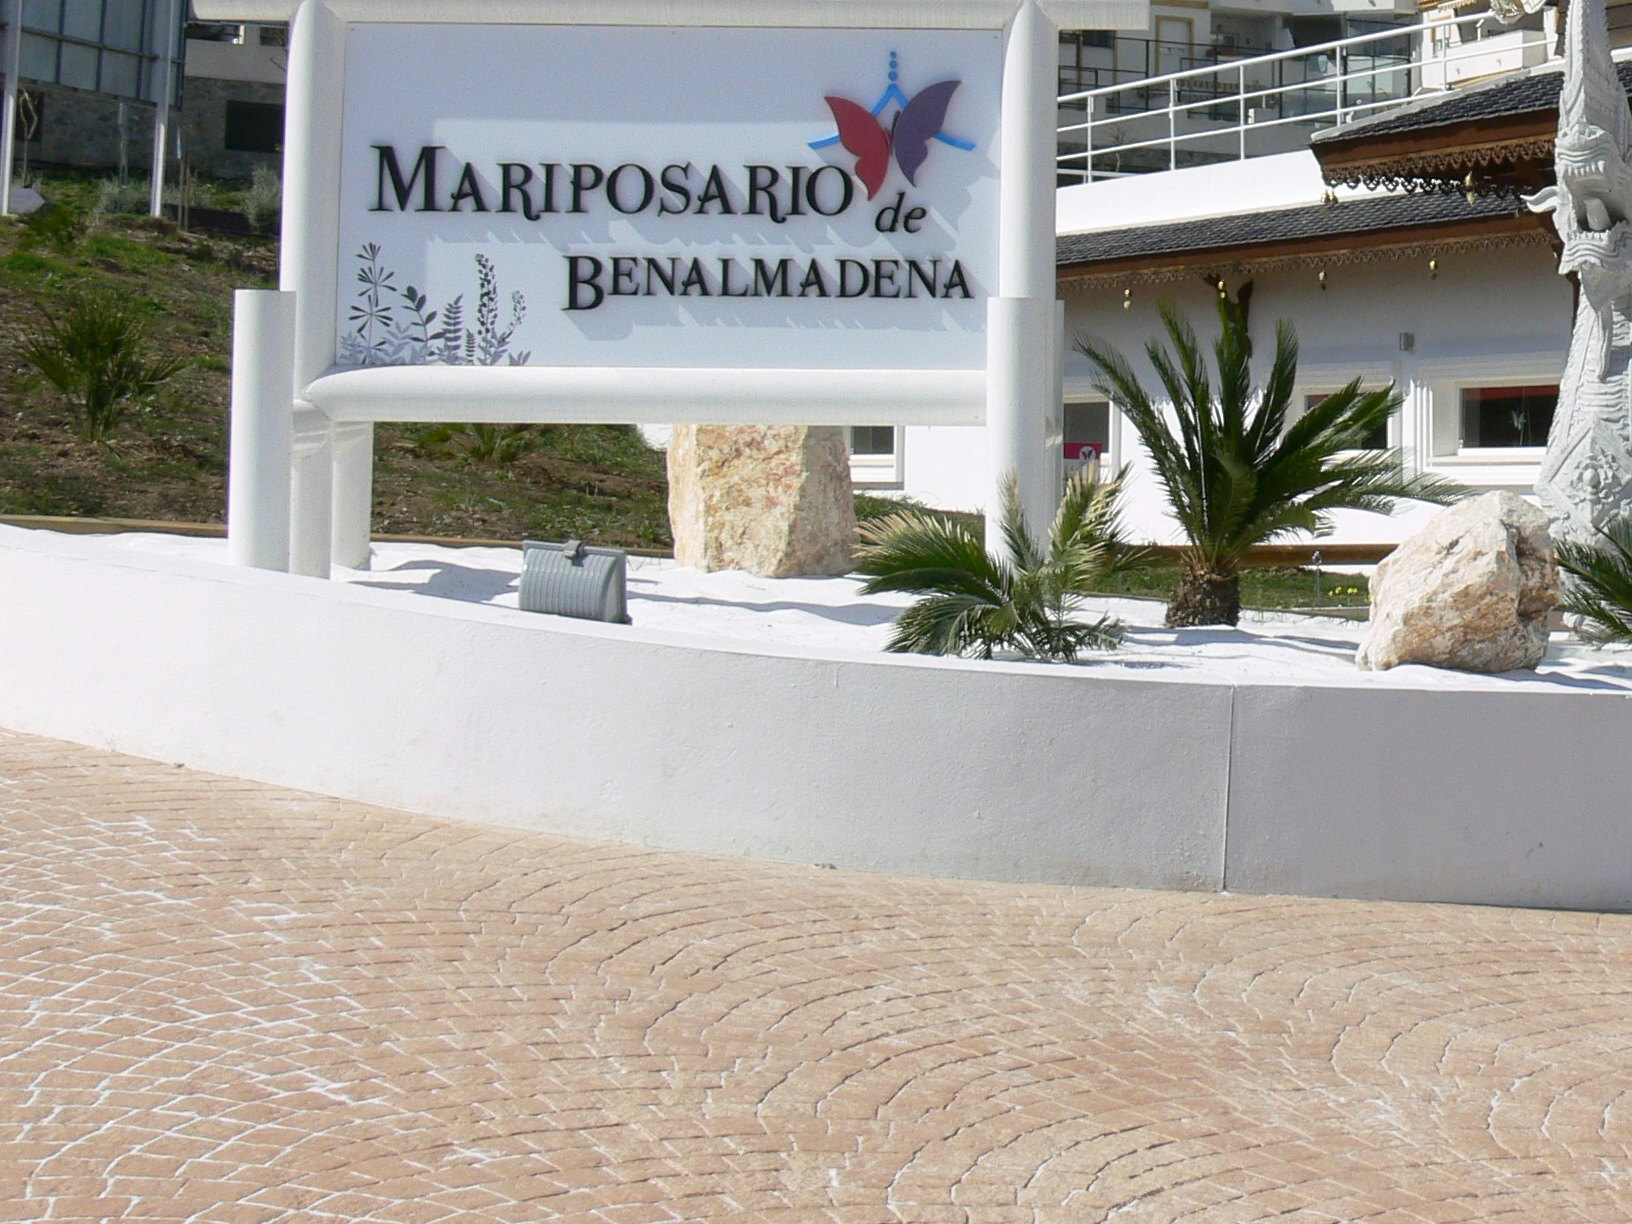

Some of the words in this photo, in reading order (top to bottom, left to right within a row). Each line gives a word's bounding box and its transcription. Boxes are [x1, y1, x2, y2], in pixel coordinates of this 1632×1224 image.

[368, 144, 855, 223] MARIPOSARIO
[873, 190, 927, 234] de
[561, 255, 975, 311] BENALMADENA
